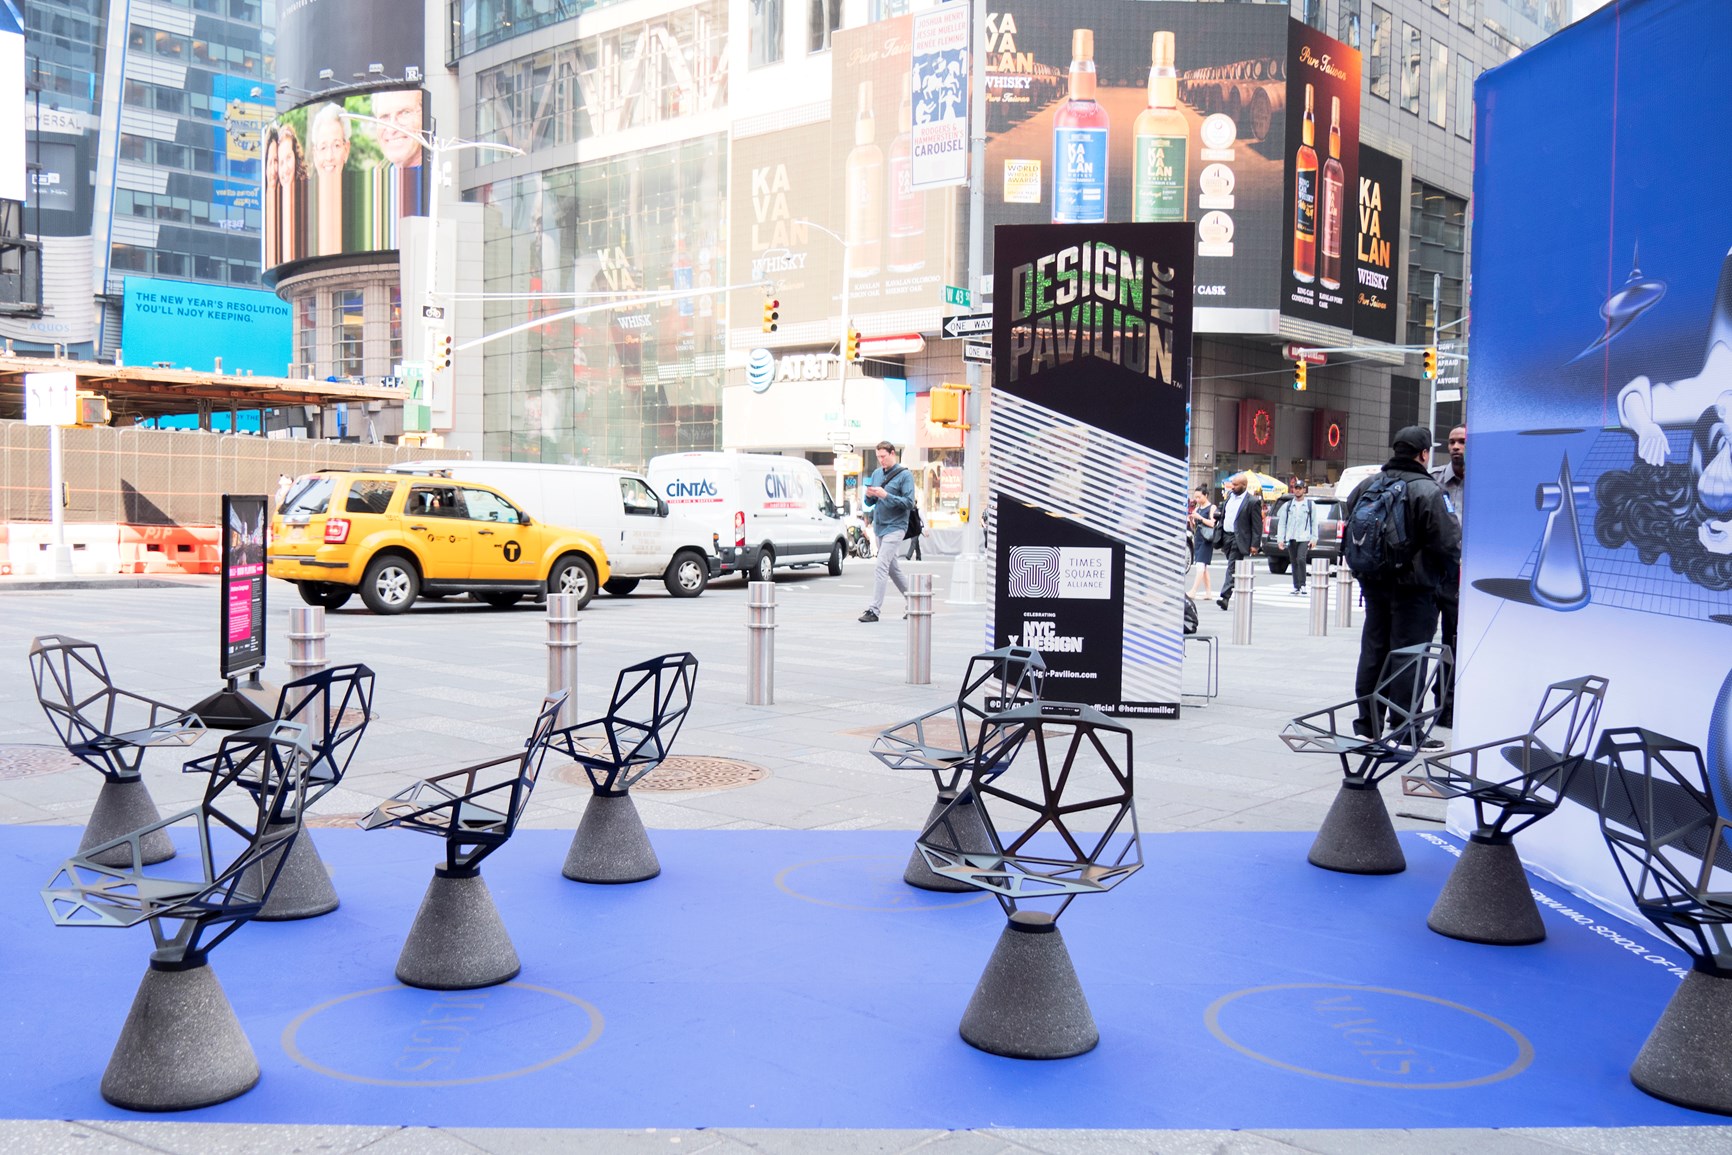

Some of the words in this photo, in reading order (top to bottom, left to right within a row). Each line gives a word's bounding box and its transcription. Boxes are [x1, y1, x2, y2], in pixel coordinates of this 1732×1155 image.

[919, 17, 942, 29] JOSHUA
[944, 11, 965, 23] HENRY
[917, 27, 936, 39] JESSIE
[938, 23, 966, 35] MUELLER
[938, 34, 965, 45] FLEMING
[1299, 45, 1319, 69] Pure
[1320, 54, 1347, 81] Taiwan
[984, 76, 1033, 89] WHISKY
[914, 131, 965, 146] HAMMERSTEIN'S
[921, 126, 951, 137] RODGERS
[914, 139, 964, 158] CAROUSEL
[1067, 162, 1093, 173] LAN
[1147, 166, 1173, 177] LAN
[752, 164, 791, 198] KA
[1359, 176, 1382, 212] KA
[752, 192, 791, 224] VA
[1359, 205, 1381, 239] VA
[752, 217, 809, 252] LAN
[597, 246, 631, 271] KA
[1357, 232, 1391, 269] LAN
[752, 253, 808, 274] WHISKY
[603, 267, 638, 291] VA
[1011, 240, 1144, 322] DESIGN
[1357, 268, 1390, 291] WHISKY
[945, 288, 953, 301] W
[955, 290, 964, 304] 43
[1150, 260, 1175, 325] NYC
[1197, 285, 1227, 296] CASK
[135, 303, 174, 315] YOU'LL
[177, 307, 205, 318] NJOY
[207, 311, 254, 323] KEEPING.
[136, 292, 157, 302] THE
[160, 294, 184, 305] NEW
[187, 298, 224, 309] YEAR'S
[226, 301, 289, 316] RESOLUTION
[29, 321, 72, 334] AQUOS
[950, 321, 967, 331] ONE
[973, 319, 992, 329] WAY
[968, 346, 981, 356] ONE
[1010, 300, 1173, 385] PAVILION
[777, 354, 829, 382] AT&T
[1437, 359, 1459, 367] AFRAID
[1173, 380, 1183, 390] TM
[1437, 377, 1459, 385] ANYONE
[666, 478, 718, 497] CINTAS
[765, 468, 804, 499] CINTAS
[1069, 558, 1103, 567] TIMES
[1064, 570, 1106, 579] SQUARE
[1067, 581, 1104, 589] ALLIANCE
[1023, 620, 1056, 637] NYC
[1022, 636, 1083, 653] DESIGN
[1118, 704, 1176, 715] @hermanmiller
[1588, 925, 1650, 955] SCHOOL
[1643, 955, 1676, 967] OF
